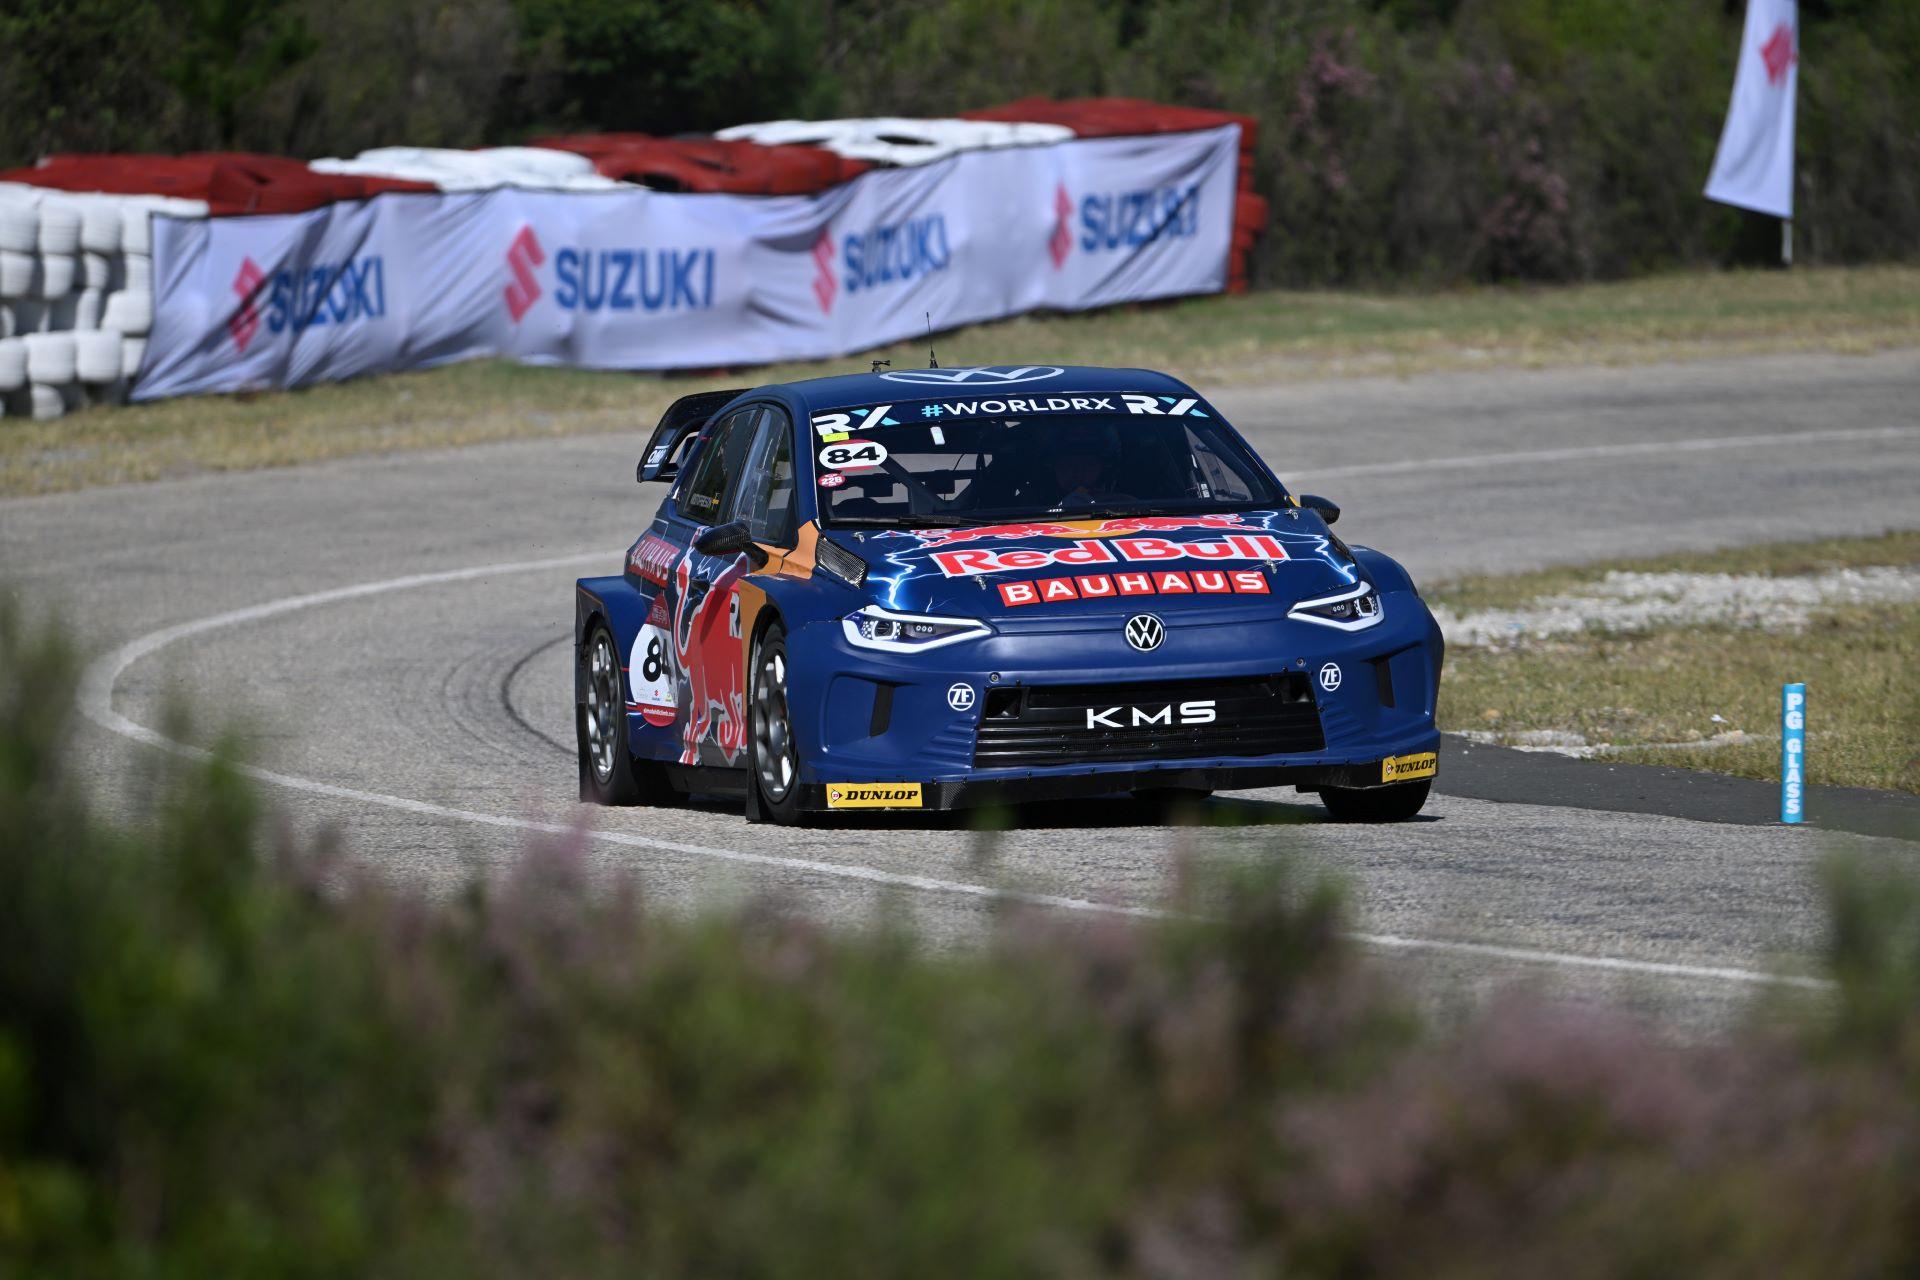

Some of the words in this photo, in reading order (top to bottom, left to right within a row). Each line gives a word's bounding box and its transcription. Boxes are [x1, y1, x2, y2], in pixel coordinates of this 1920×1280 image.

[1081, 186, 1199, 251] SUZUKI
[844, 213, 949, 292] SUZUKI
[267, 255, 385, 334] SUZUKI
[554, 247, 714, 310] SUZUKI
[811, 405, 900, 436] RX
[921, 397, 1116, 417] #WORLDRX
[1120, 394, 1210, 418] RX
[827, 446, 880, 464] 84
[928, 539, 1118, 578] Red
[1109, 534, 1291, 562] Bull
[1004, 573, 1263, 602] BAUHAUS
[642, 635, 672, 684] 84
[1086, 700, 1216, 729] KMS
[1785, 693, 1803, 730] PG
[1395, 758, 1436, 774] DUNLOP
[1785, 738, 1802, 814] GLASS
[845, 790, 918, 801] DUNLOP
